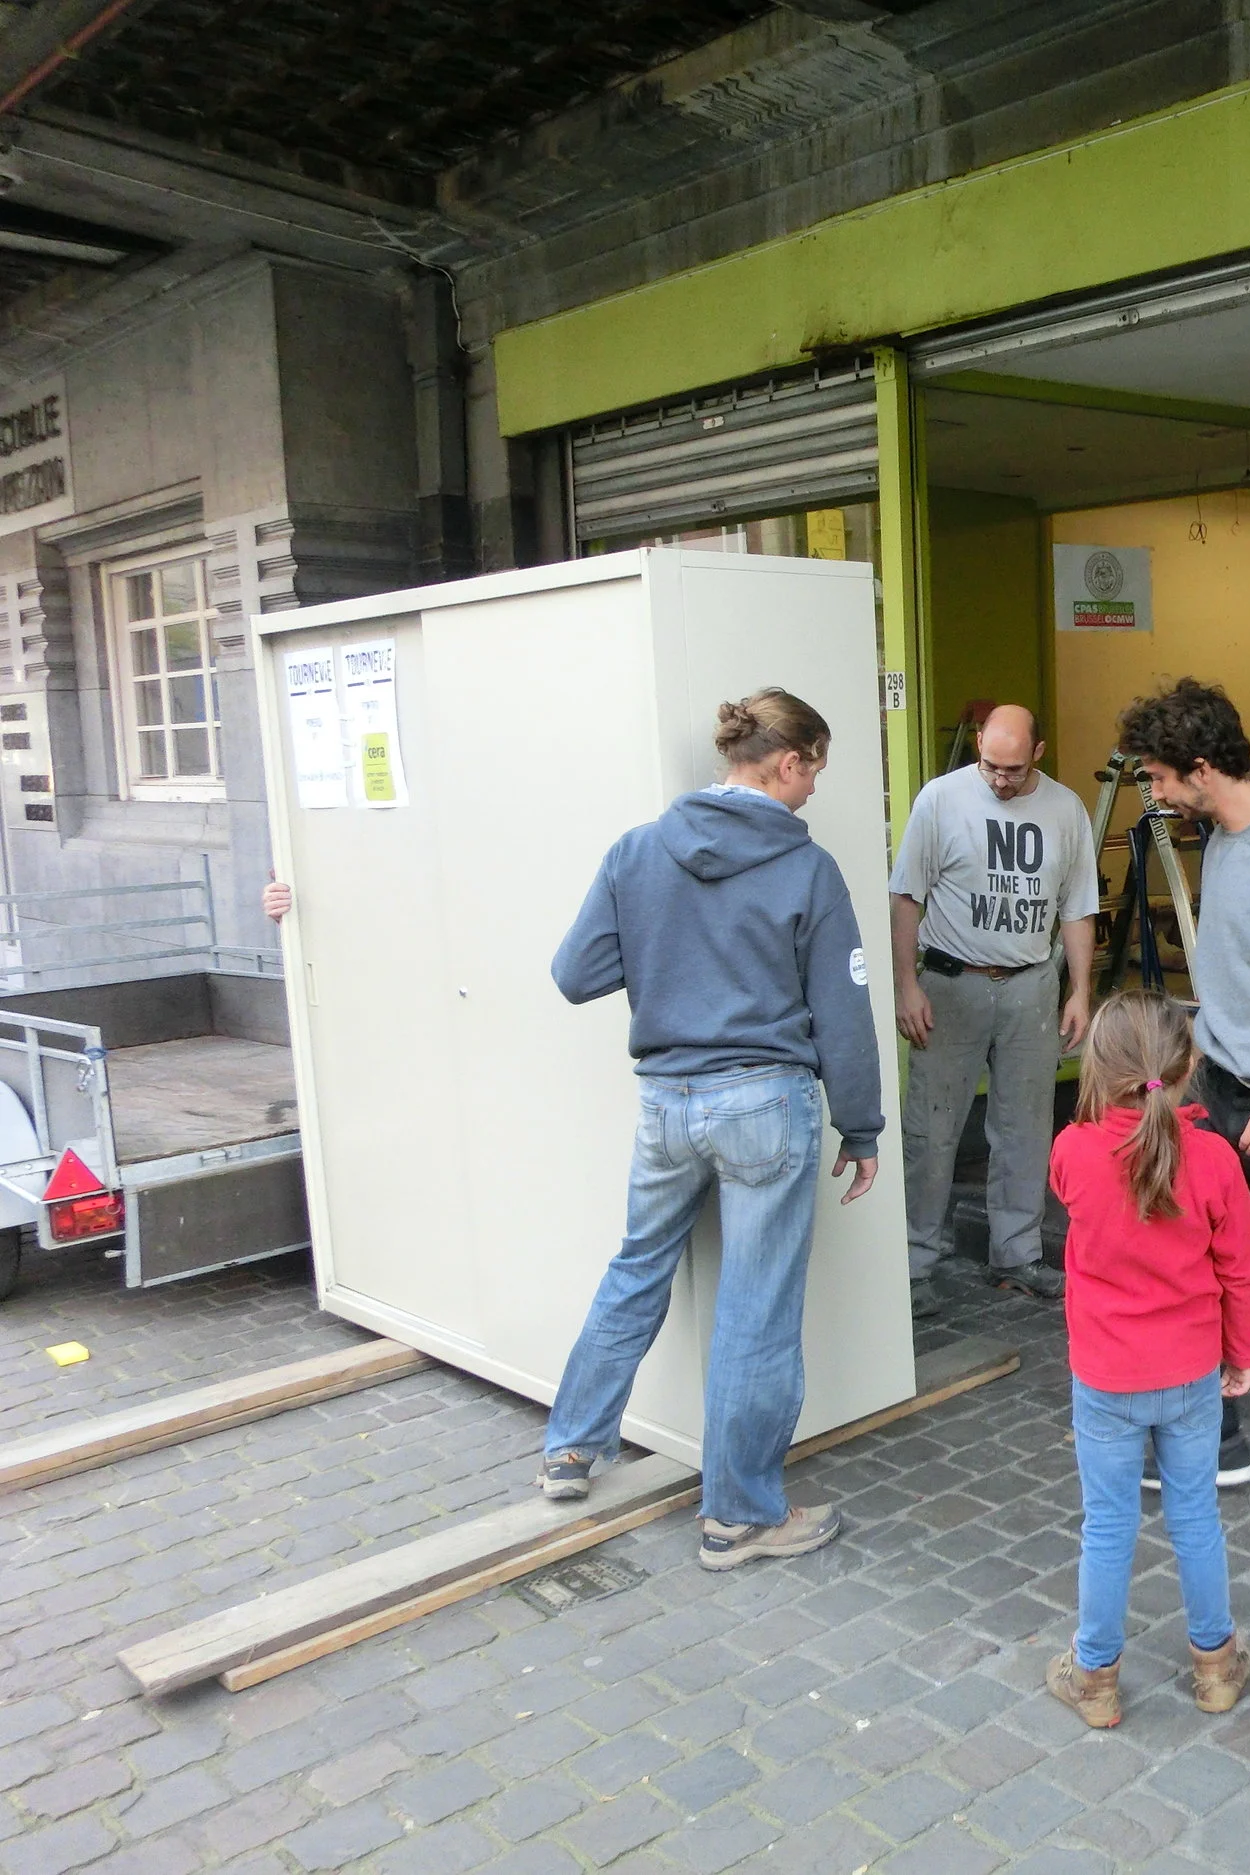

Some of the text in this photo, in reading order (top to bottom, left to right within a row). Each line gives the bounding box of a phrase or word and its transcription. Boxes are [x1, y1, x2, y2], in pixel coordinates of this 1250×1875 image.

[1074, 604, 1098, 613] CPAS
[1105, 615, 1134, 624] OCMW
[887, 673, 904, 690] 298
[893, 692, 900, 708] B
[368, 746, 386, 759] cera
[986, 819, 1044, 874] NO
[987, 873, 1041, 896] TIME TO
[970, 892, 1049, 935] WASTE
